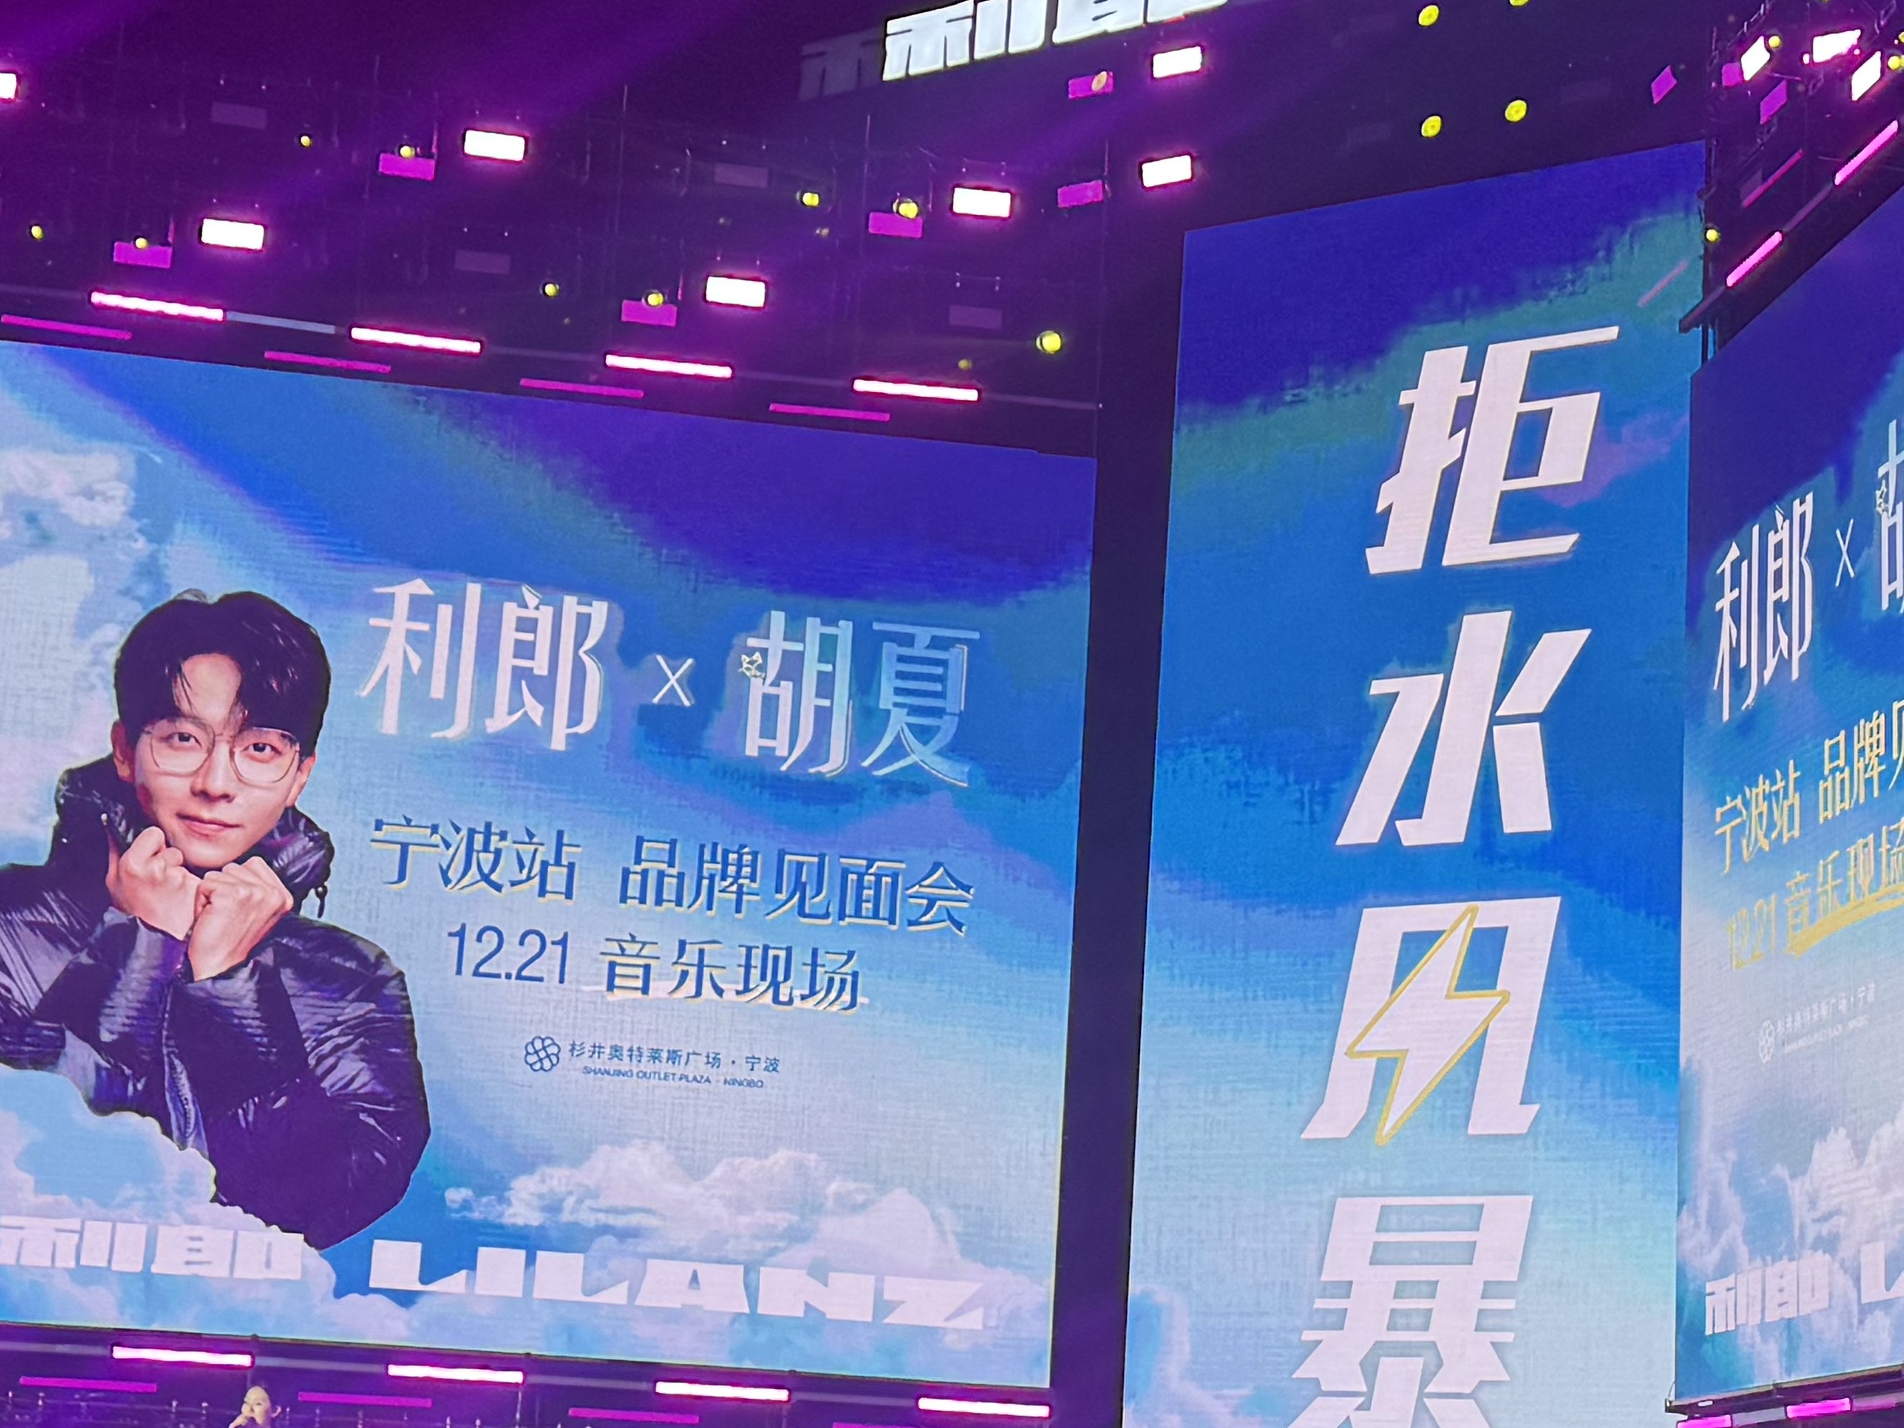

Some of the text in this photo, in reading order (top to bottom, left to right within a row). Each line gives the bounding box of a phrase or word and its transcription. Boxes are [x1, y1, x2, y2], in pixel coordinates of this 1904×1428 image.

[1711, 490, 1814, 723] 利郎
[358, 577, 608, 751] 利郎
[741, 609, 981, 787] 胡夏
[1713, 759, 1802, 876] 宁波站
[370, 814, 976, 937] 宁波站 品牌见面会
[447, 921, 863, 1012] 12.21 音乐现场
[636, 1070, 677, 1083] OUTLET
[678, 1073, 712, 1085] PLAZA
[723, 1077, 765, 1089] NINGBO
[368, 1238, 985, 1330] LILANZ
[1704, 1250, 1831, 1337] 利郎
